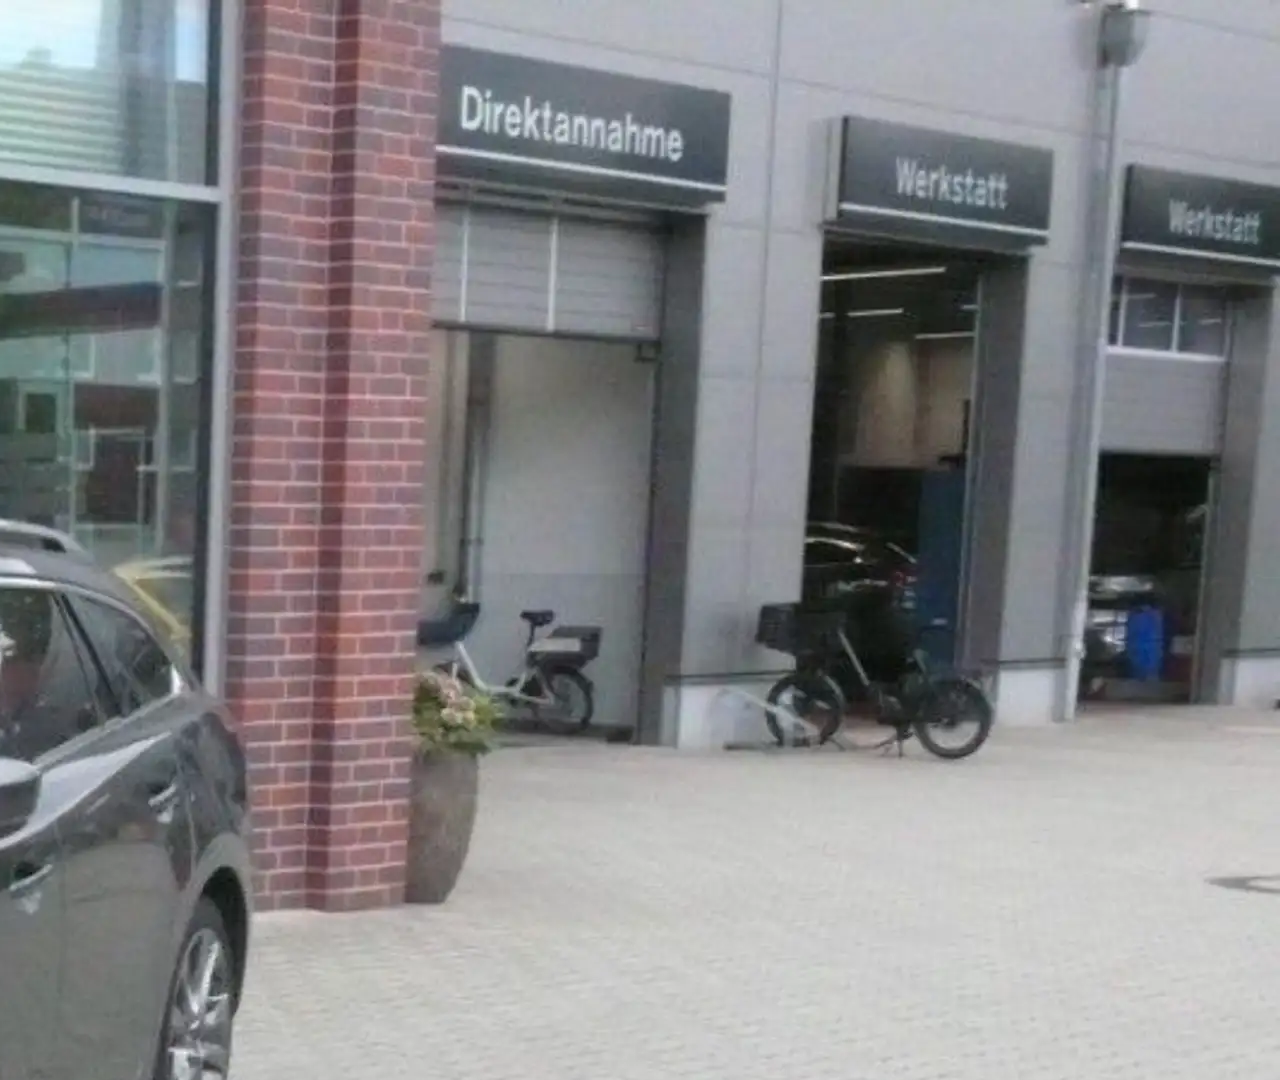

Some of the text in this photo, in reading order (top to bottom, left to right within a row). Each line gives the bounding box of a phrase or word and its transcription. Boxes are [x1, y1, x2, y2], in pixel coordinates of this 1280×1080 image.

[460, 85, 684, 163] Direktannahme
[895, 156, 1009, 210] Werkstatt
[1168, 199, 1261, 245] Werkstatt
